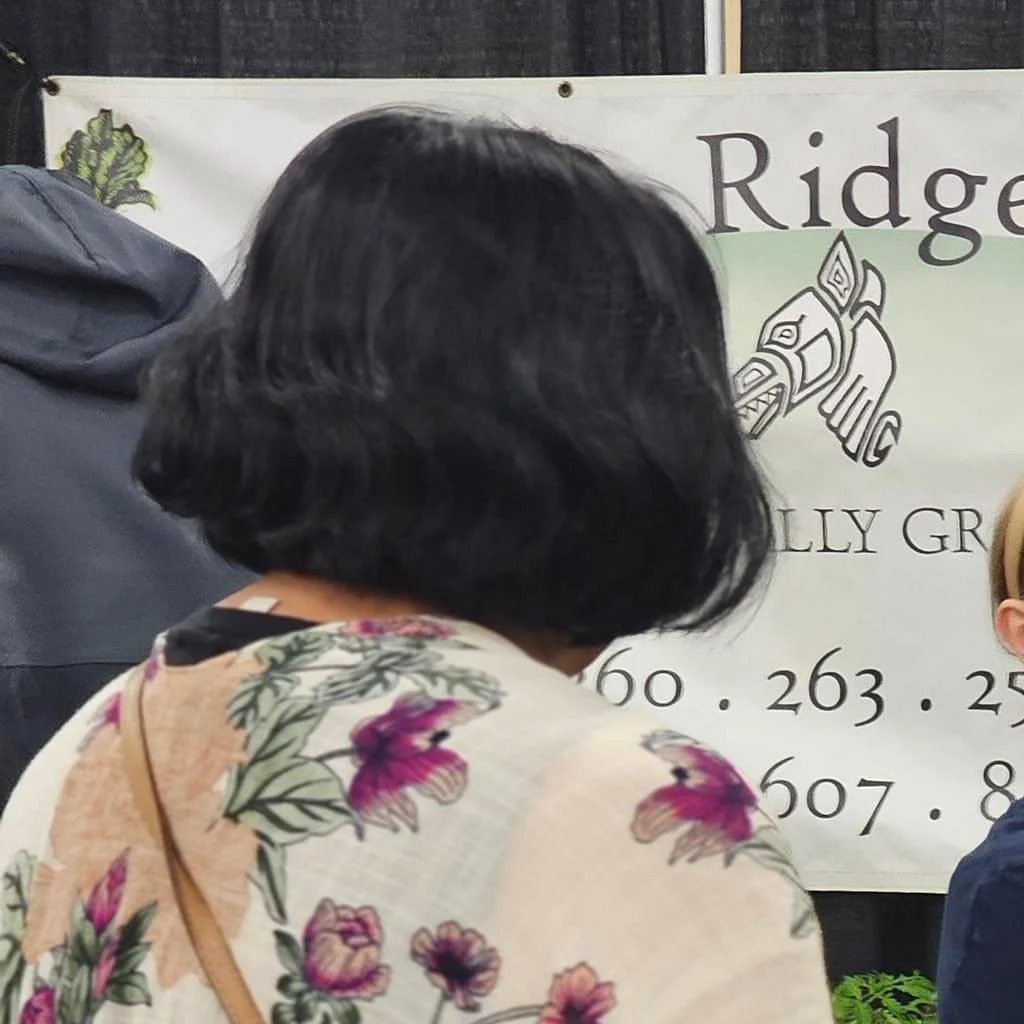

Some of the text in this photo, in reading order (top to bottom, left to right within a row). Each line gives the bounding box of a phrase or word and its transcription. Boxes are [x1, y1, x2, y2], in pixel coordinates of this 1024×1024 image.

[776, 507, 882, 554] LLY
[902, 507, 989, 555] GR
[576, 647, 684, 707] 60
[766, 647, 884, 727] 263
[760, 756, 895, 836] 607
